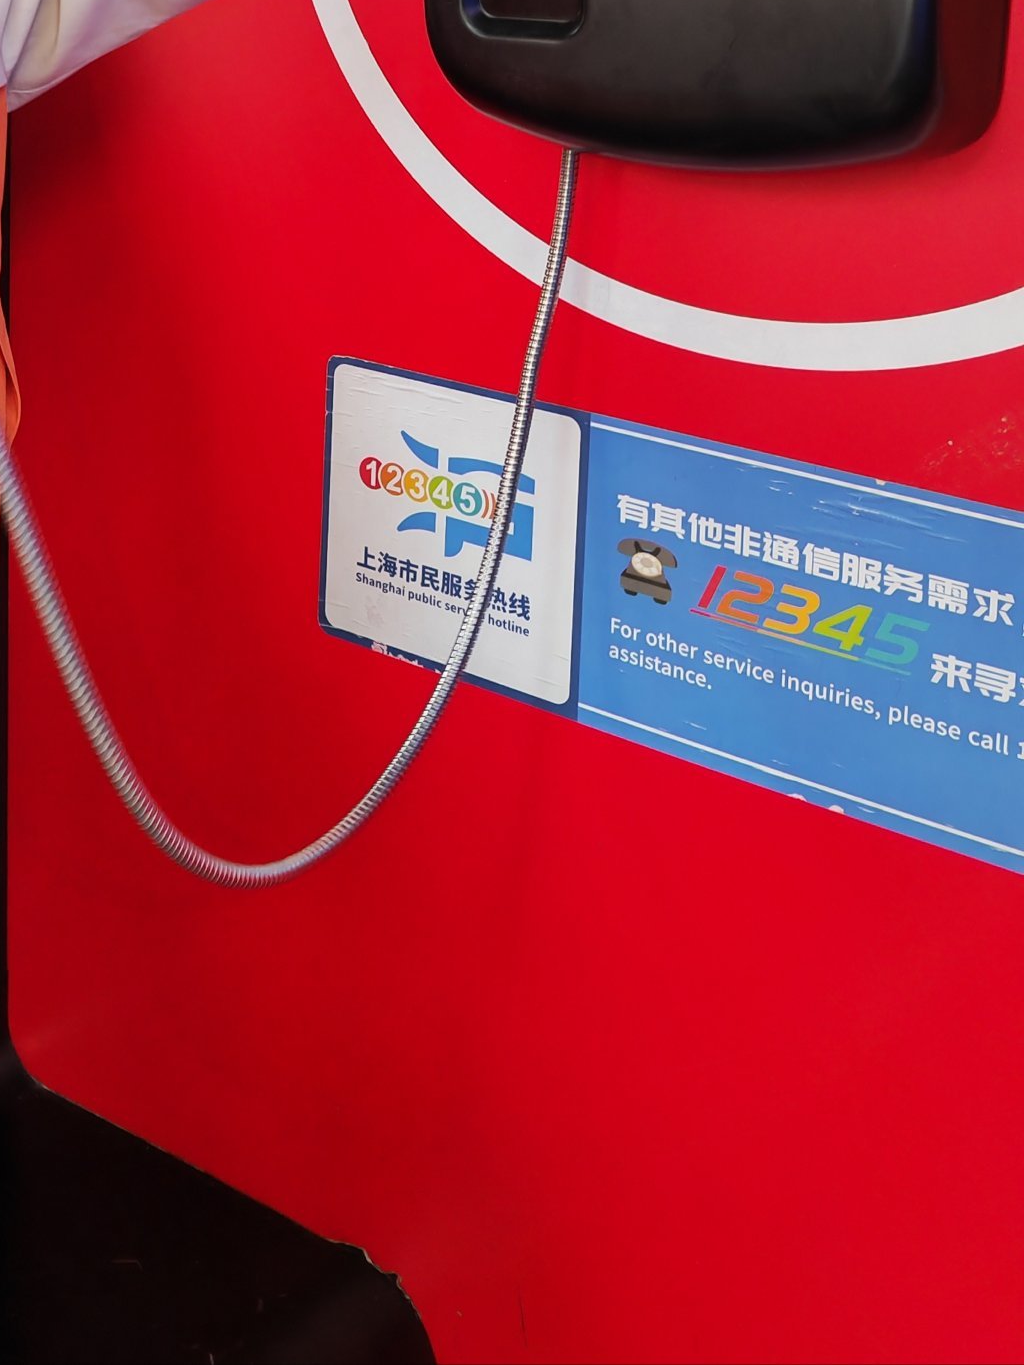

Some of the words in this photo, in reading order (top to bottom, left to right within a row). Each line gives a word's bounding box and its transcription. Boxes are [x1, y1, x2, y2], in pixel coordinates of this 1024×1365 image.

[362, 458, 479, 515] 12345
[356, 546, 531, 621] 上海市民服务热线
[616, 494, 1015, 626] 有其他非通信服务需求
[355, 572, 406, 597] Shanghai
[408, 590, 442, 609] public
[488, 613, 530, 637] hotline
[697, 565, 931, 665] 12345
[931, 653, 1024, 707] 来寻
[608, 642, 713, 691] assistance.
[610, 617, 640, 641] For
[646, 630, 698, 659] other
[703, 647, 774, 684] service
[780, 668, 881, 719] inquiries,
[888, 704, 961, 741] please
[968, 730, 1009, 756] call
